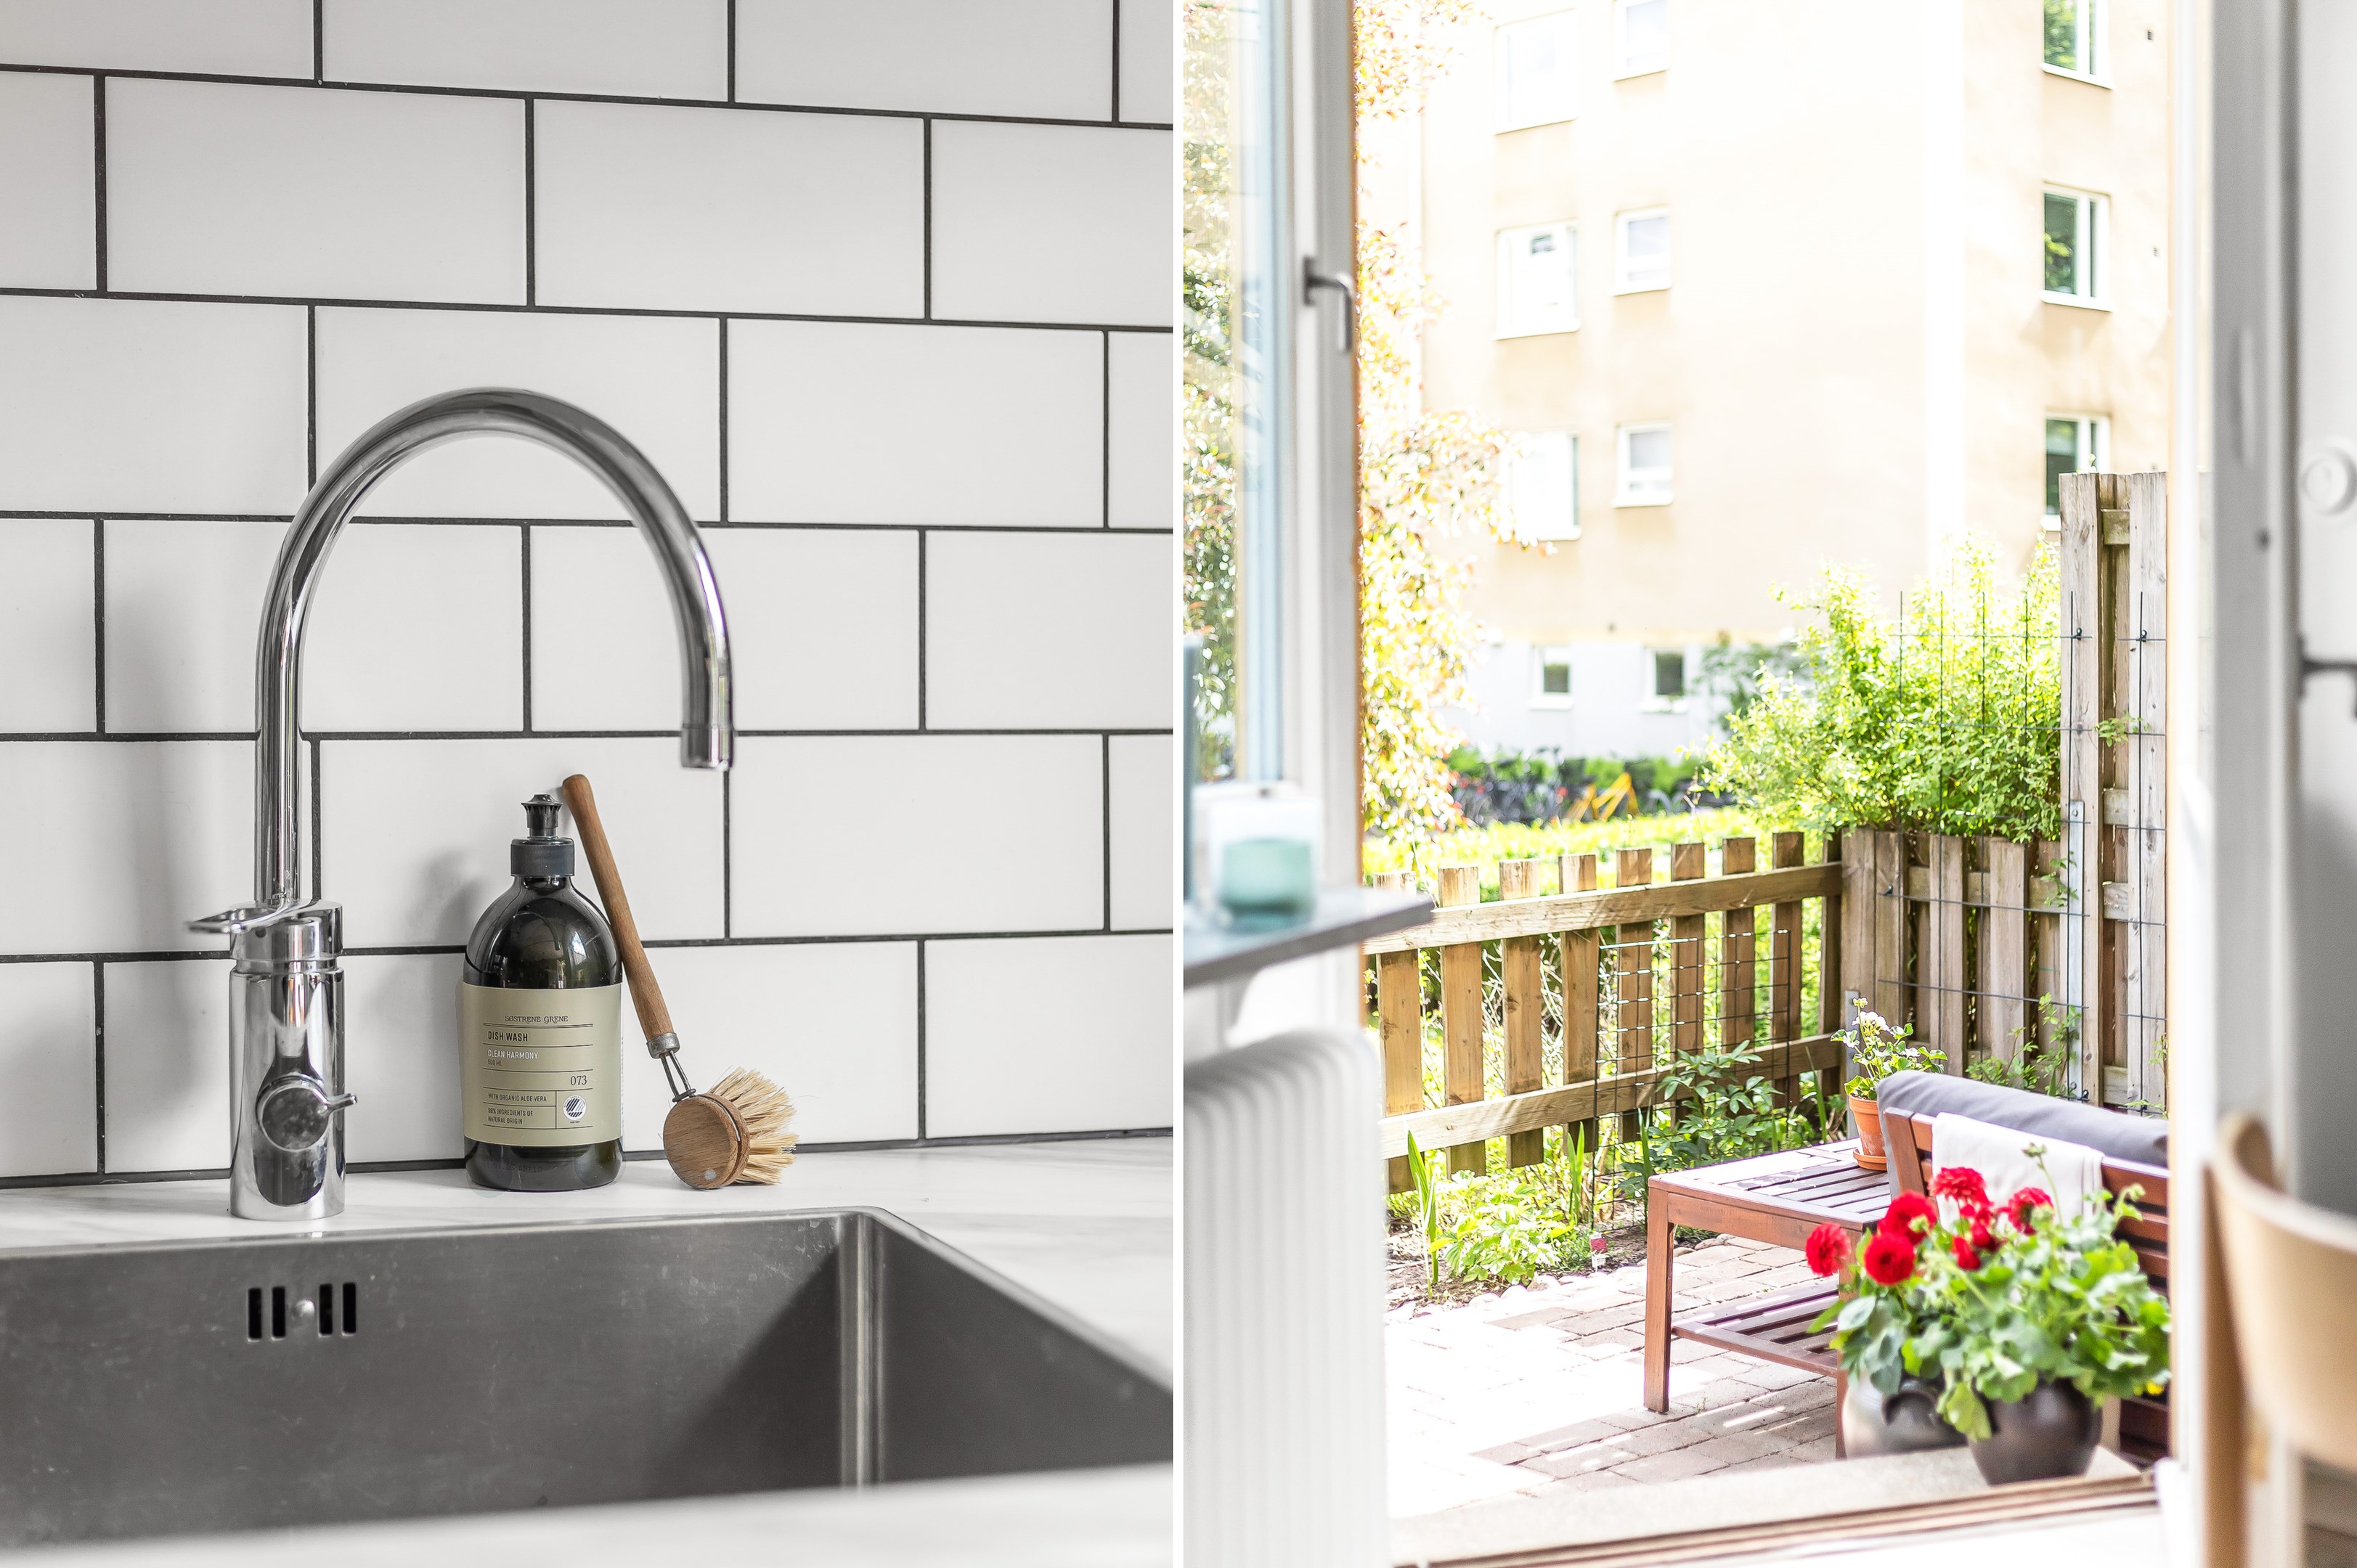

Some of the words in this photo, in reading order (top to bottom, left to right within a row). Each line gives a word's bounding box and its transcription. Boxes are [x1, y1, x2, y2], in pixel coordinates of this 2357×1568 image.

[488, 1031, 504, 1040] DISH
[506, 1032, 528, 1042] WASH
[488, 1049, 505, 1058] CLEAN
[507, 1050, 538, 1059] HARMONY
[570, 1075, 587, 1086] 073
